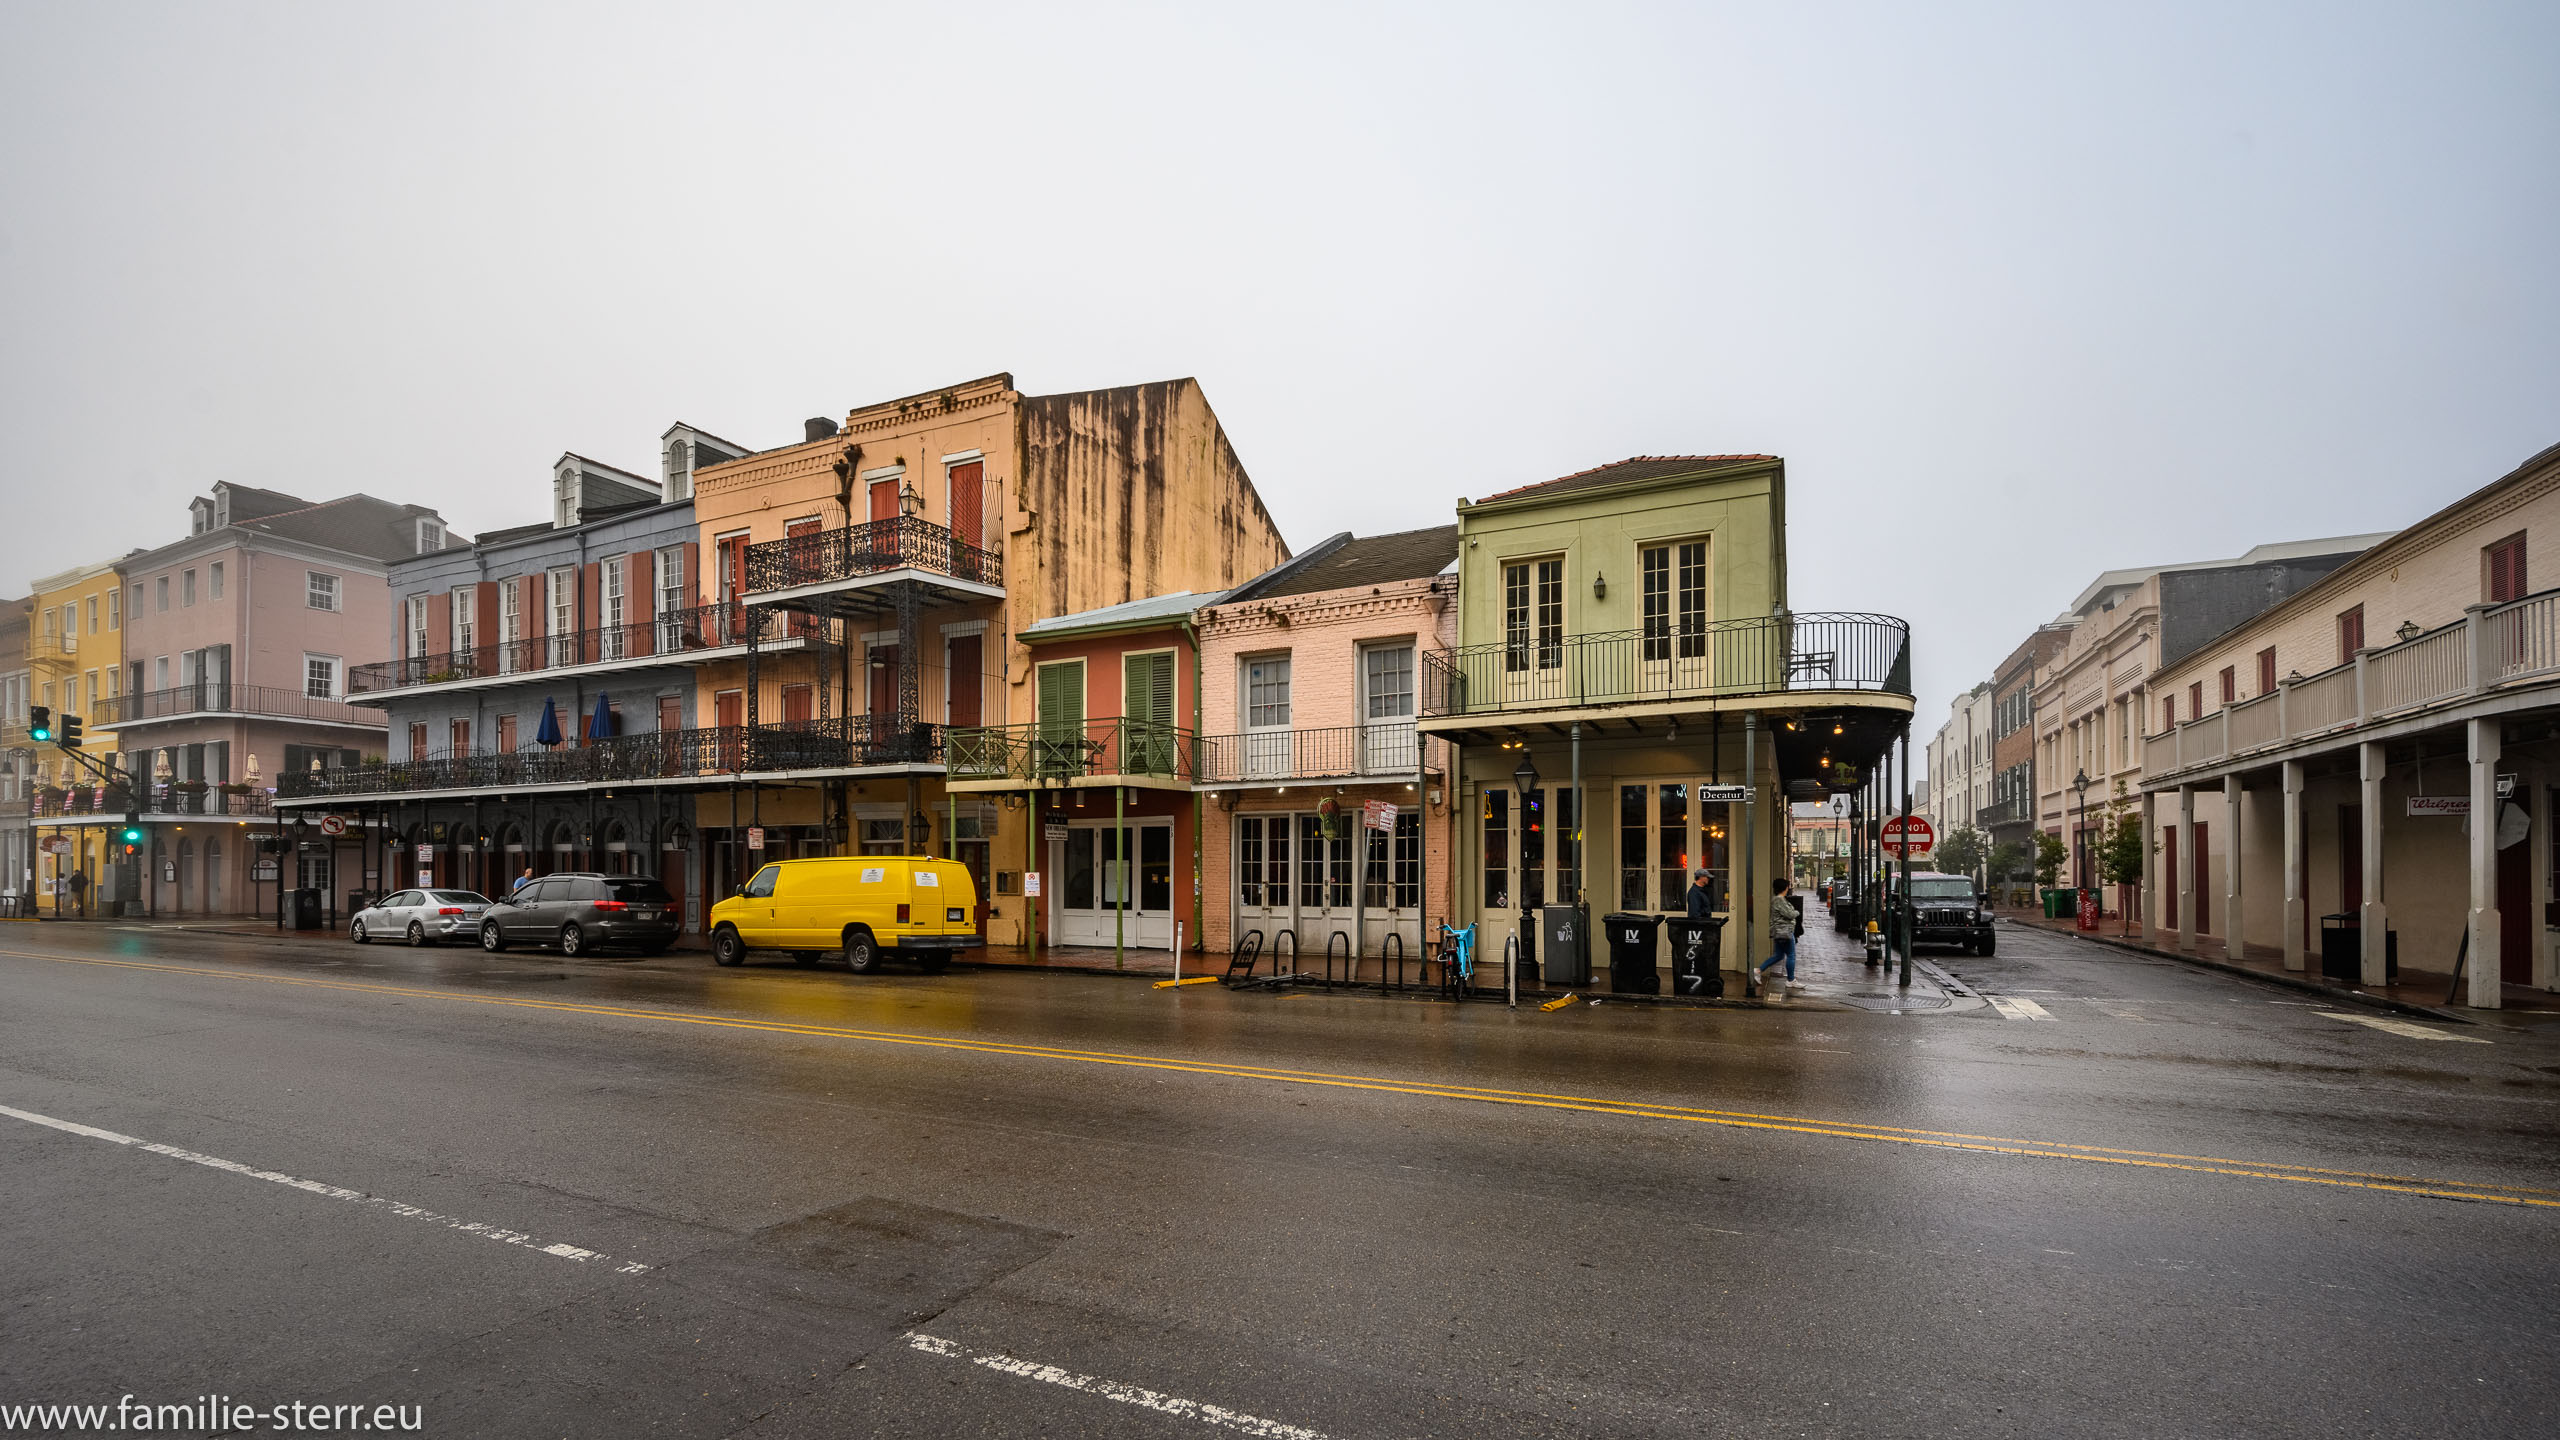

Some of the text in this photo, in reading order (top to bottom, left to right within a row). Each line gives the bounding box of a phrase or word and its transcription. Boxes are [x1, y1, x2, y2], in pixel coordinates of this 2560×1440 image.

[1702, 791, 1742, 799] Decatur
[2411, 799, 2471, 811] Walgree
[1888, 823, 1926, 832] DO NOT
[1891, 844, 1922, 852] ENER
[1625, 929, 1639, 939] IV
[1687, 930, 1702, 940] IV
